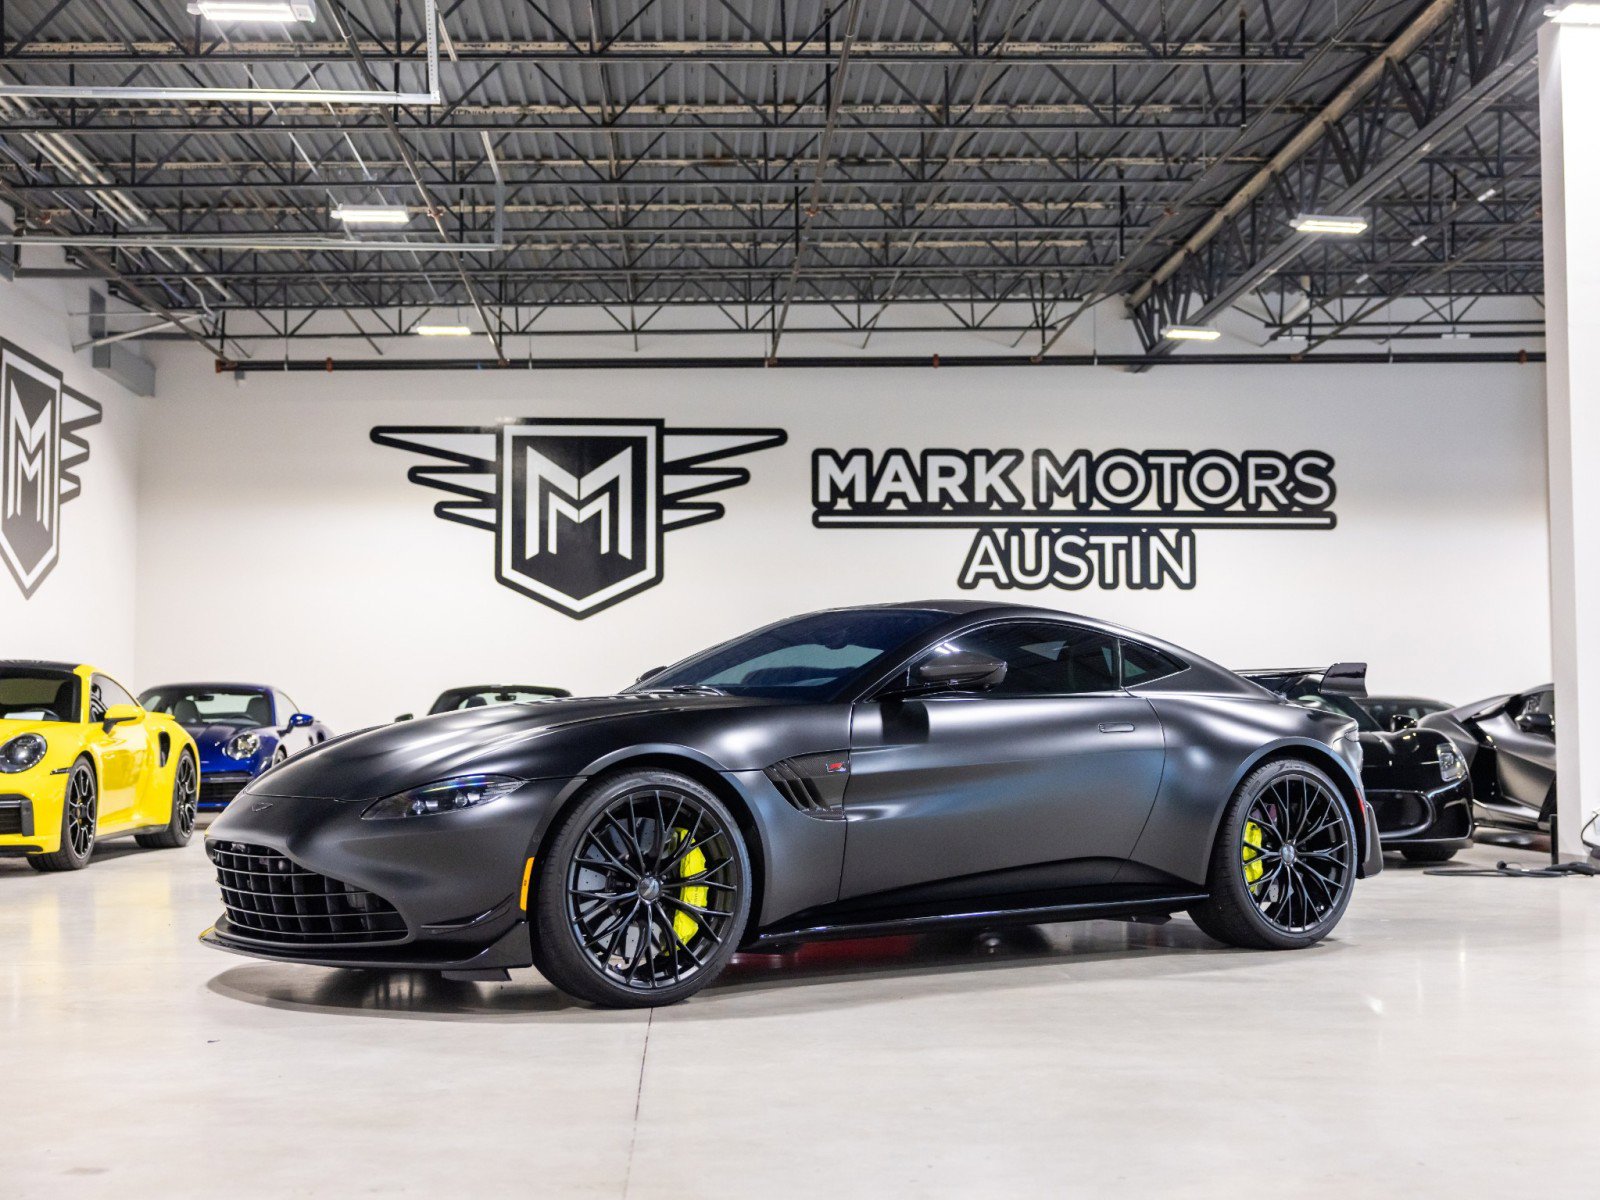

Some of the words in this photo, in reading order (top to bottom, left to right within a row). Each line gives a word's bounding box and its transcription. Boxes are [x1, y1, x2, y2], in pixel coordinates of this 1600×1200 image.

[816, 453, 1023, 504] MARK
[1036, 454, 1332, 506] MOTORS
[962, 534, 1192, 586] AUSTIN
